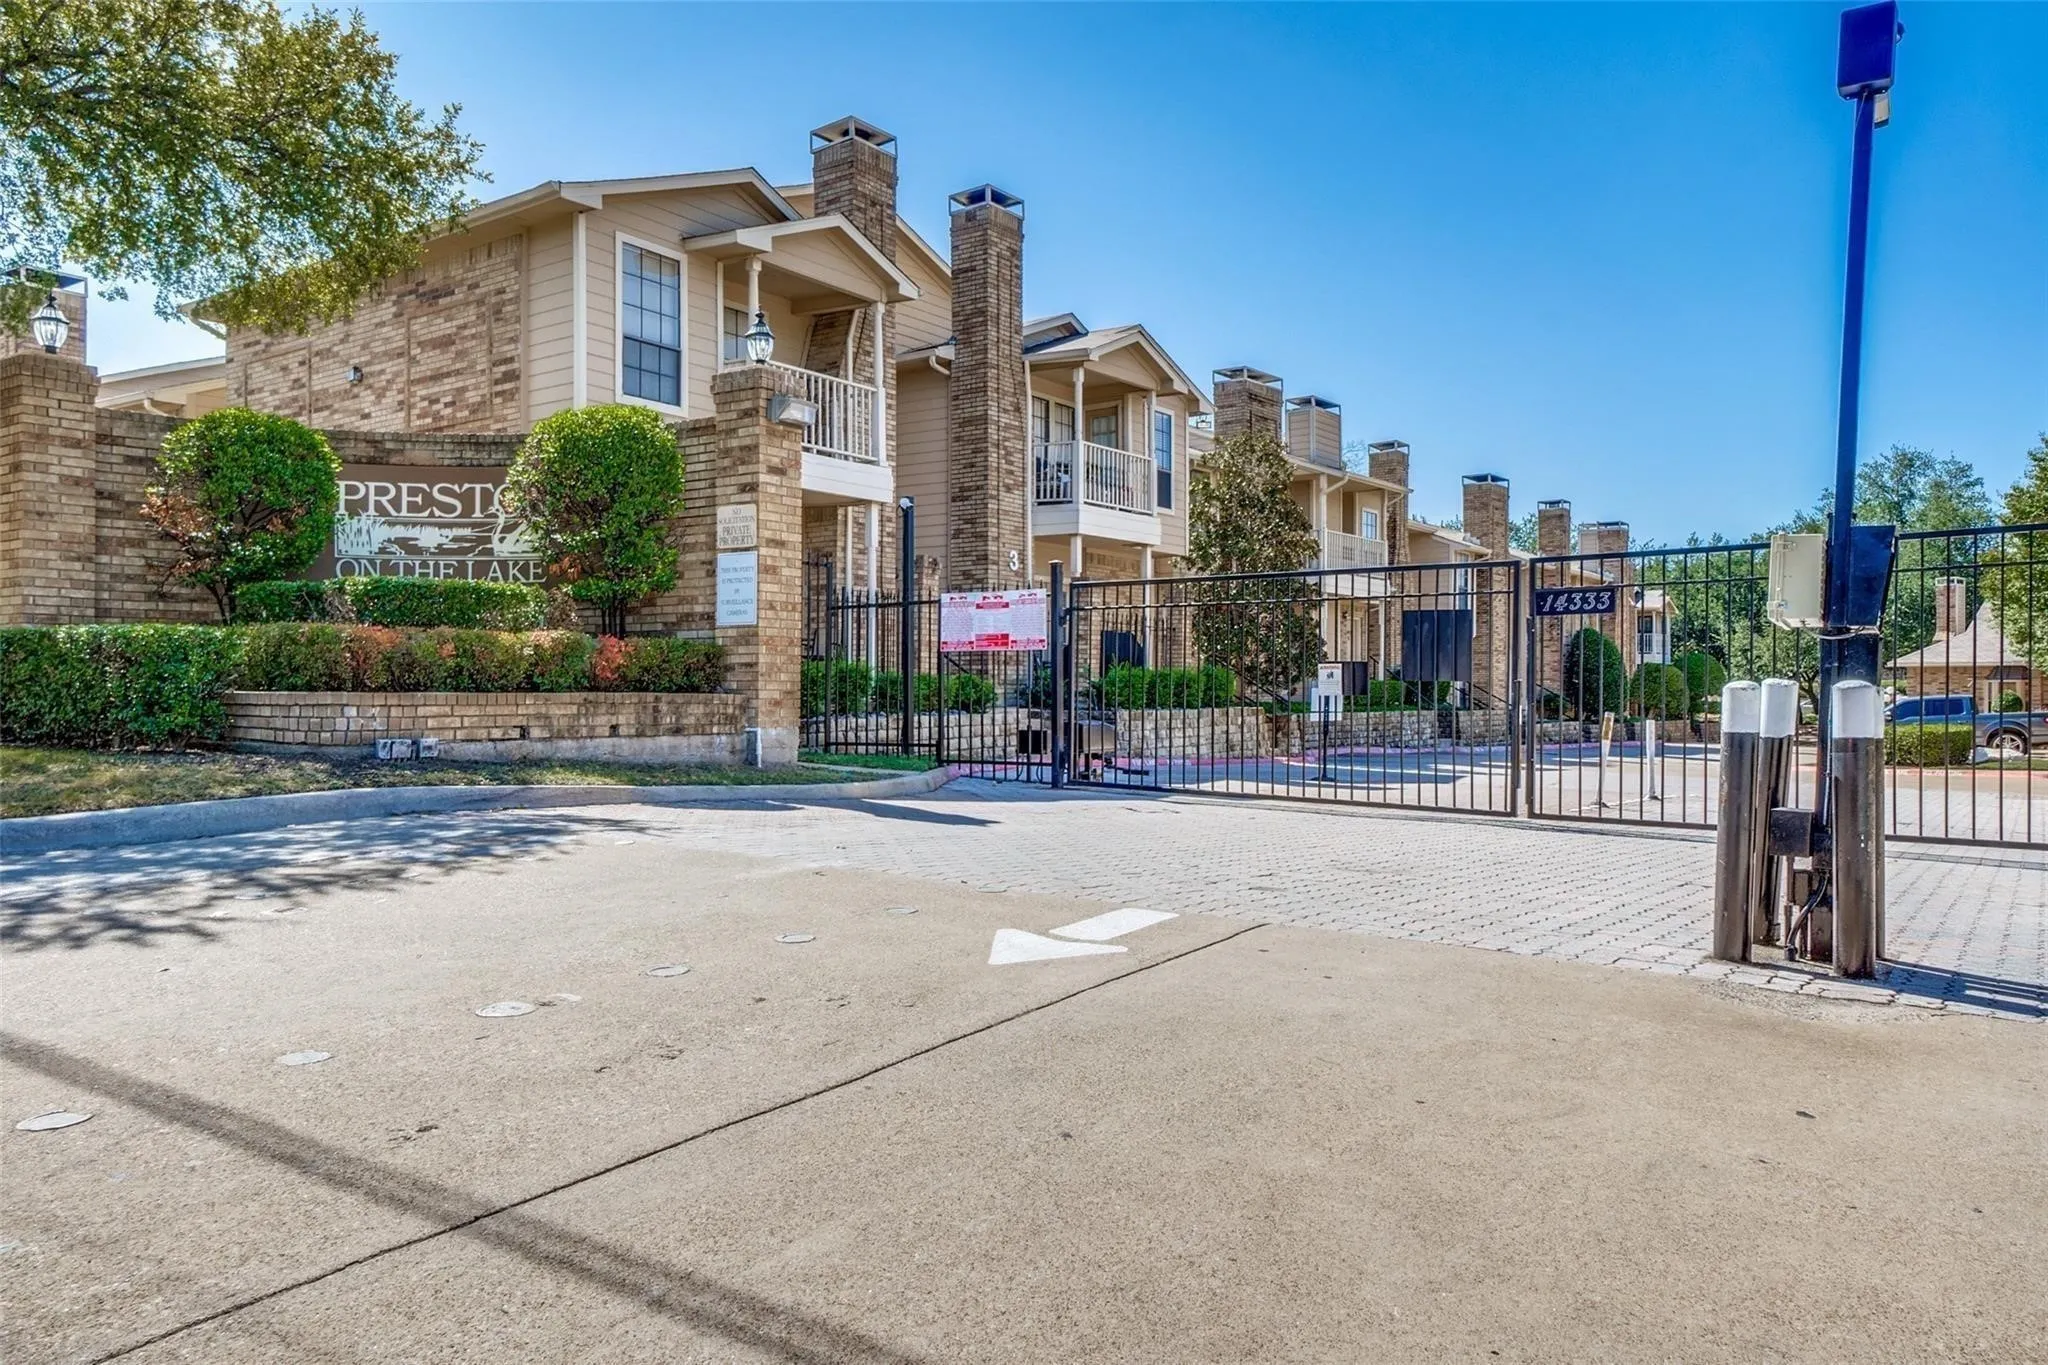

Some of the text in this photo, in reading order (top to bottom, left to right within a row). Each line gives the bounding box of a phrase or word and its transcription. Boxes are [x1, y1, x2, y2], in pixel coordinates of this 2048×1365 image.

[336, 481, 518, 518] PRESTO
[719, 535, 754, 547] PROPERTY
[722, 525, 751, 537] PRIVATE
[1009, 550, 1018, 571] 3
[336, 559, 548, 584] ON THE LAKE
[1542, 591, 1612, 612] 14333
